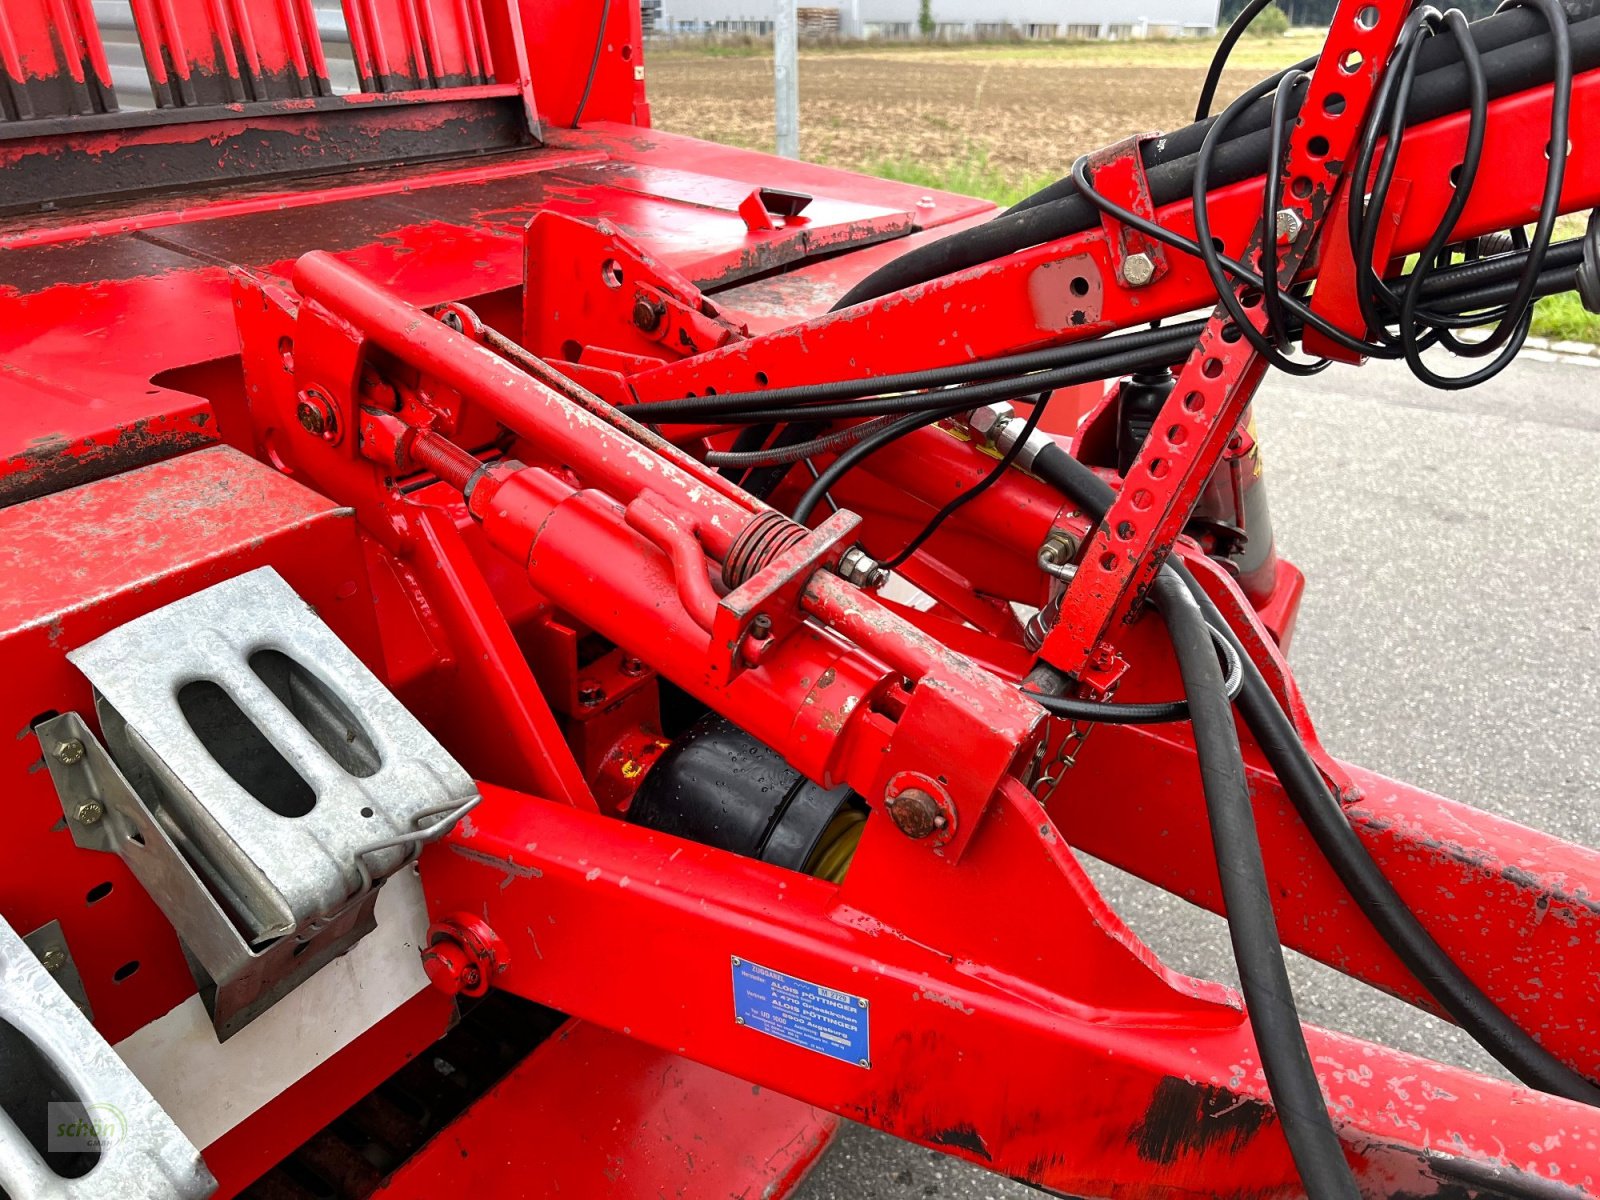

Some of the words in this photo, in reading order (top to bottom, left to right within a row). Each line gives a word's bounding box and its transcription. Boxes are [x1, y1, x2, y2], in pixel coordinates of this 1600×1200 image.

[771, 982, 799, 995] ALOIS
[802, 991, 857, 1013] PÖTTINGER
[780, 994, 800, 1005] 4710
[802, 1002, 858, 1024] Grieskirchen
[771, 999, 800, 1014] ALOIS
[803, 1009, 858, 1032] PÖTTINGER
[782, 1012, 805, 1025] 8900
[806, 1021, 848, 1039] Augsburg
